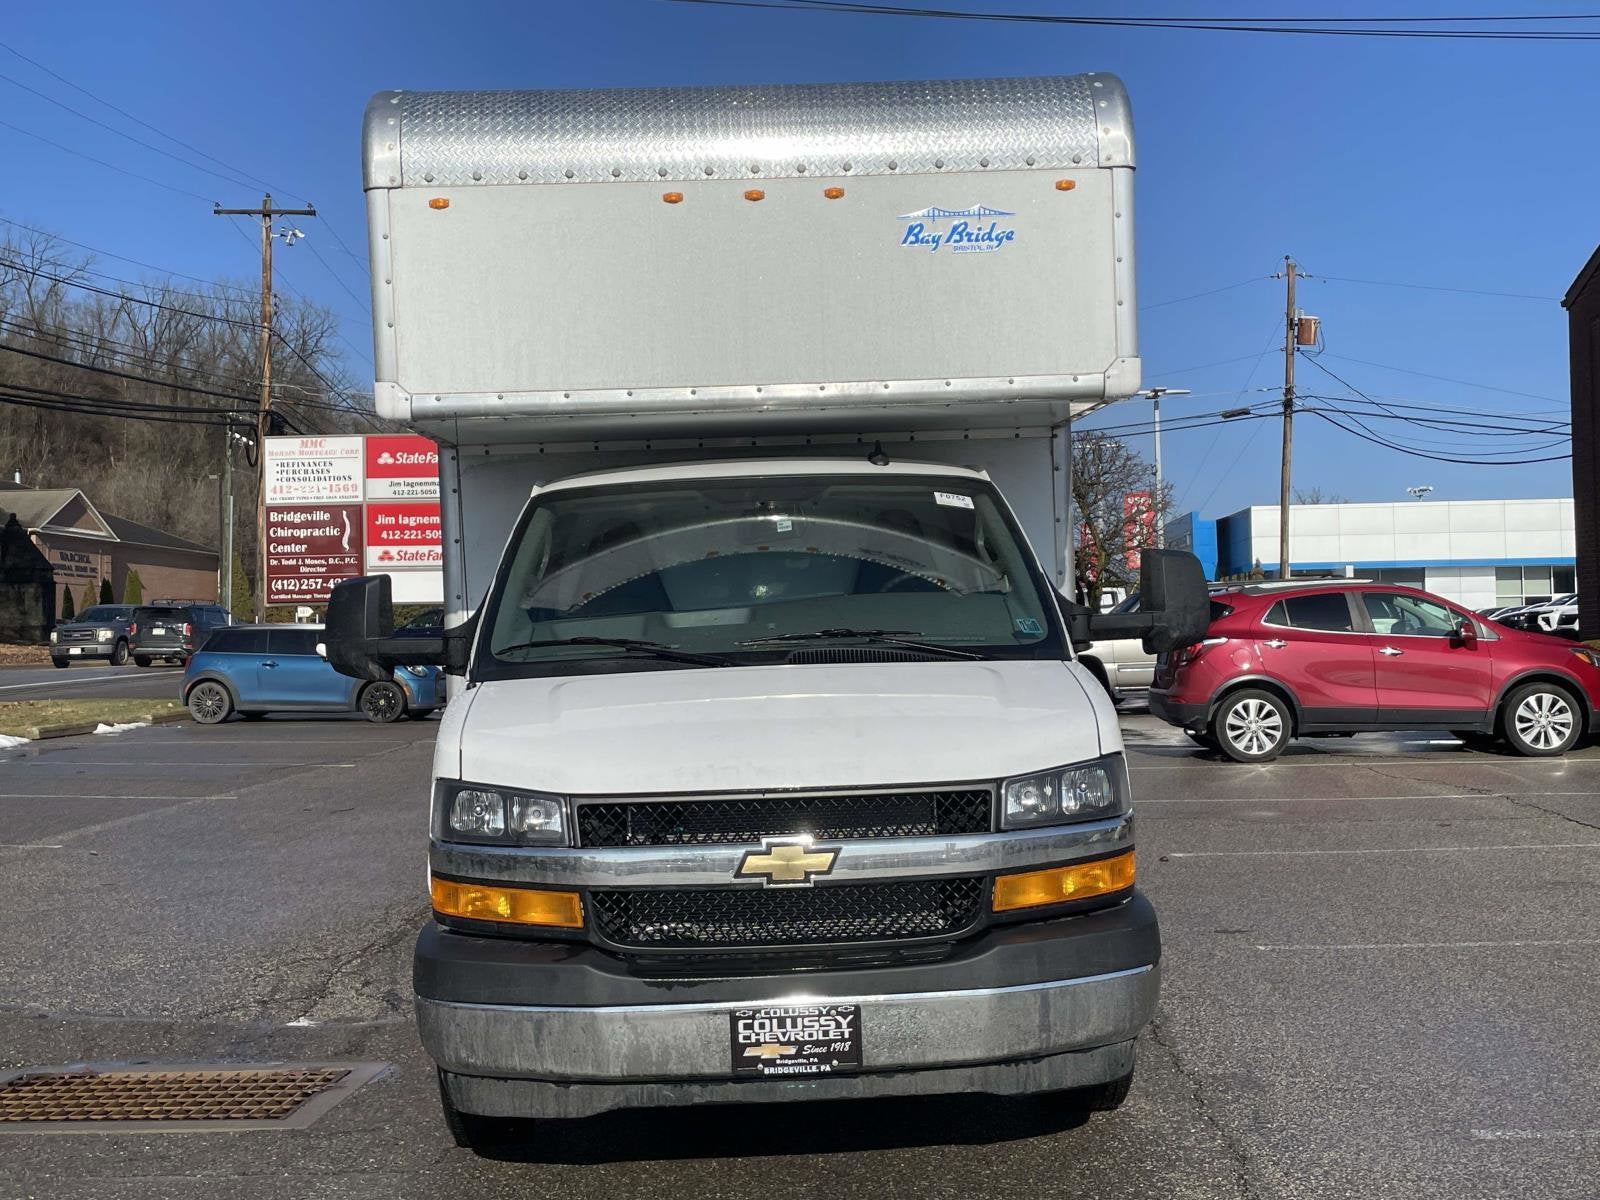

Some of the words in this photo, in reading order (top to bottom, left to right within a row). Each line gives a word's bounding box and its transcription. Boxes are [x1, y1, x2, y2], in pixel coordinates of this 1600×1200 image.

[901, 222, 942, 252] Bay
[944, 220, 1015, 249] Bridge
[299, 439, 327, 448] MMC
[280, 460, 333, 468] REFINANCES
[280, 475, 352, 483] CONSOLIDATIONS
[389, 480, 401, 488] Jim
[271, 483, 358, 495] 412-221-1569
[270, 511, 330, 523] Bridgeville
[375, 514, 396, 525] Jim
[269, 525, 341, 539] Chiropractic
[269, 542, 308, 553] Center
[304, 558, 328, 566] Moses,
[761, 1006, 831, 1018] COLUSSY
[738, 1014, 854, 1033] COLUSSY
[738, 1028, 853, 1043] CHEVROLET
[802, 1044, 828, 1055] Since
[830, 1041, 852, 1052] 1918
[820, 1064, 832, 1072] PA
